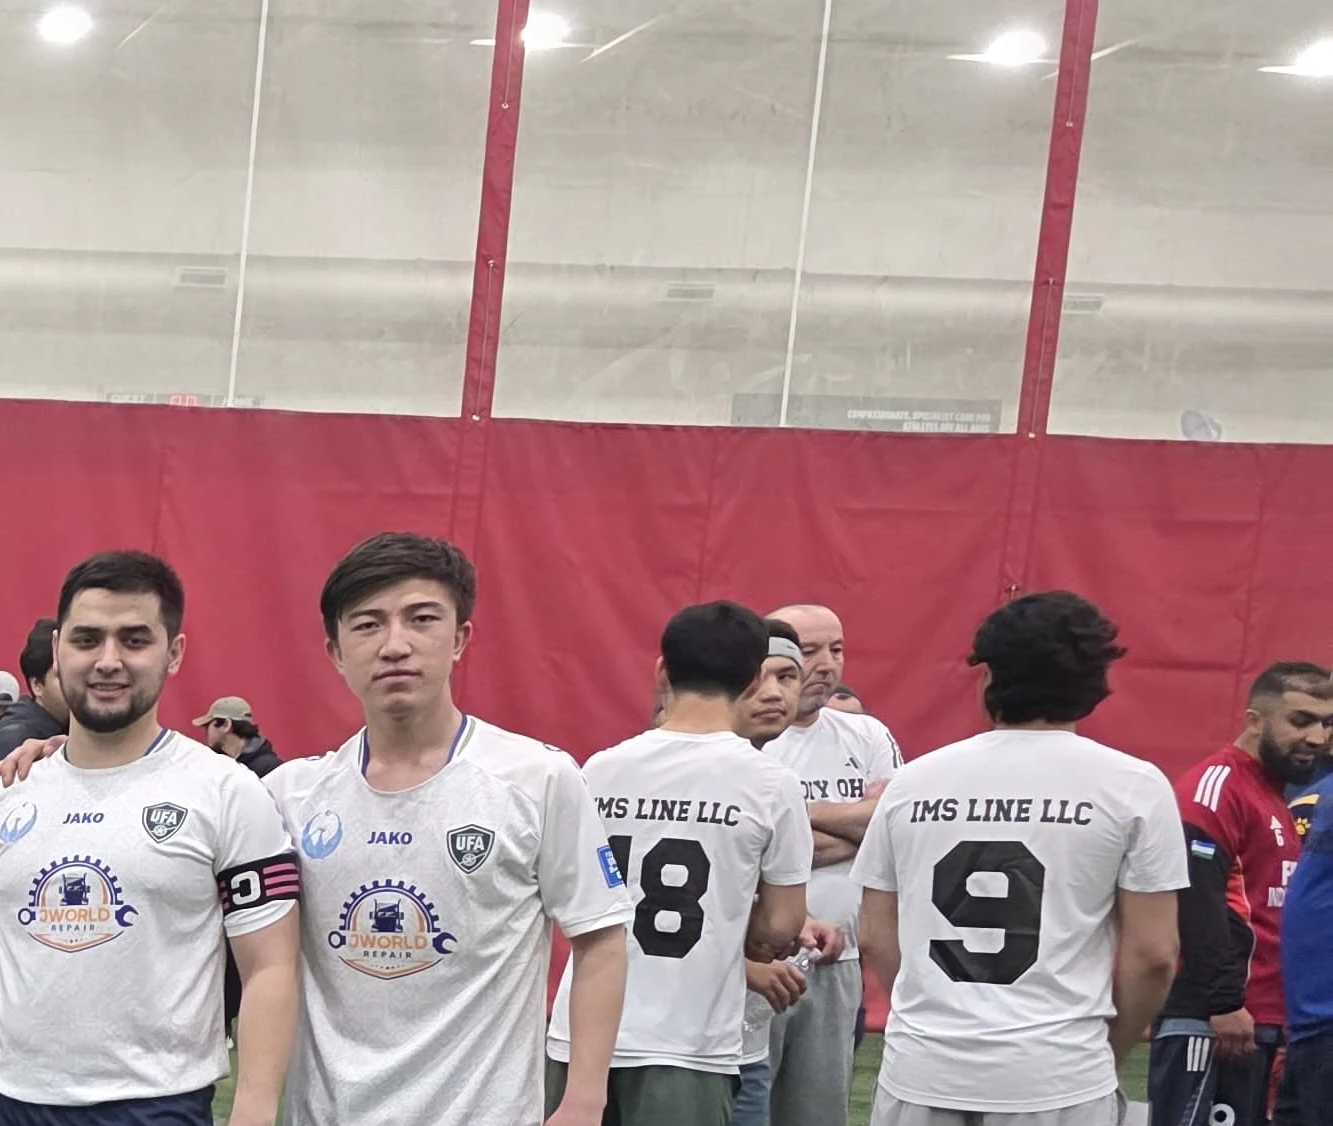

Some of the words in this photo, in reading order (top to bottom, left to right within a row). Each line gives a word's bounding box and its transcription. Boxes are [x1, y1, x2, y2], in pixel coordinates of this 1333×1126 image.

[837, 778, 864, 798] OH
[62, 812, 105, 825] JAKO
[151, 810, 177, 826] UFA
[595, 797, 629, 819] MS
[635, 798, 692, 822] LINE
[696, 801, 742, 826] LLC
[910, 798, 959, 823] IMS
[966, 798, 1033, 823] LINE
[1040, 799, 1094, 826] LLC
[367, 831, 413, 846] JAKO
[457, 835, 485, 852] UFA
[39, 908, 111, 923] JWORLD
[929, 840, 1046, 985] 9
[51, 924, 96, 932] REPAIR
[348, 934, 428, 950] JWORLD
[363, 950, 413, 960] REPAIR
